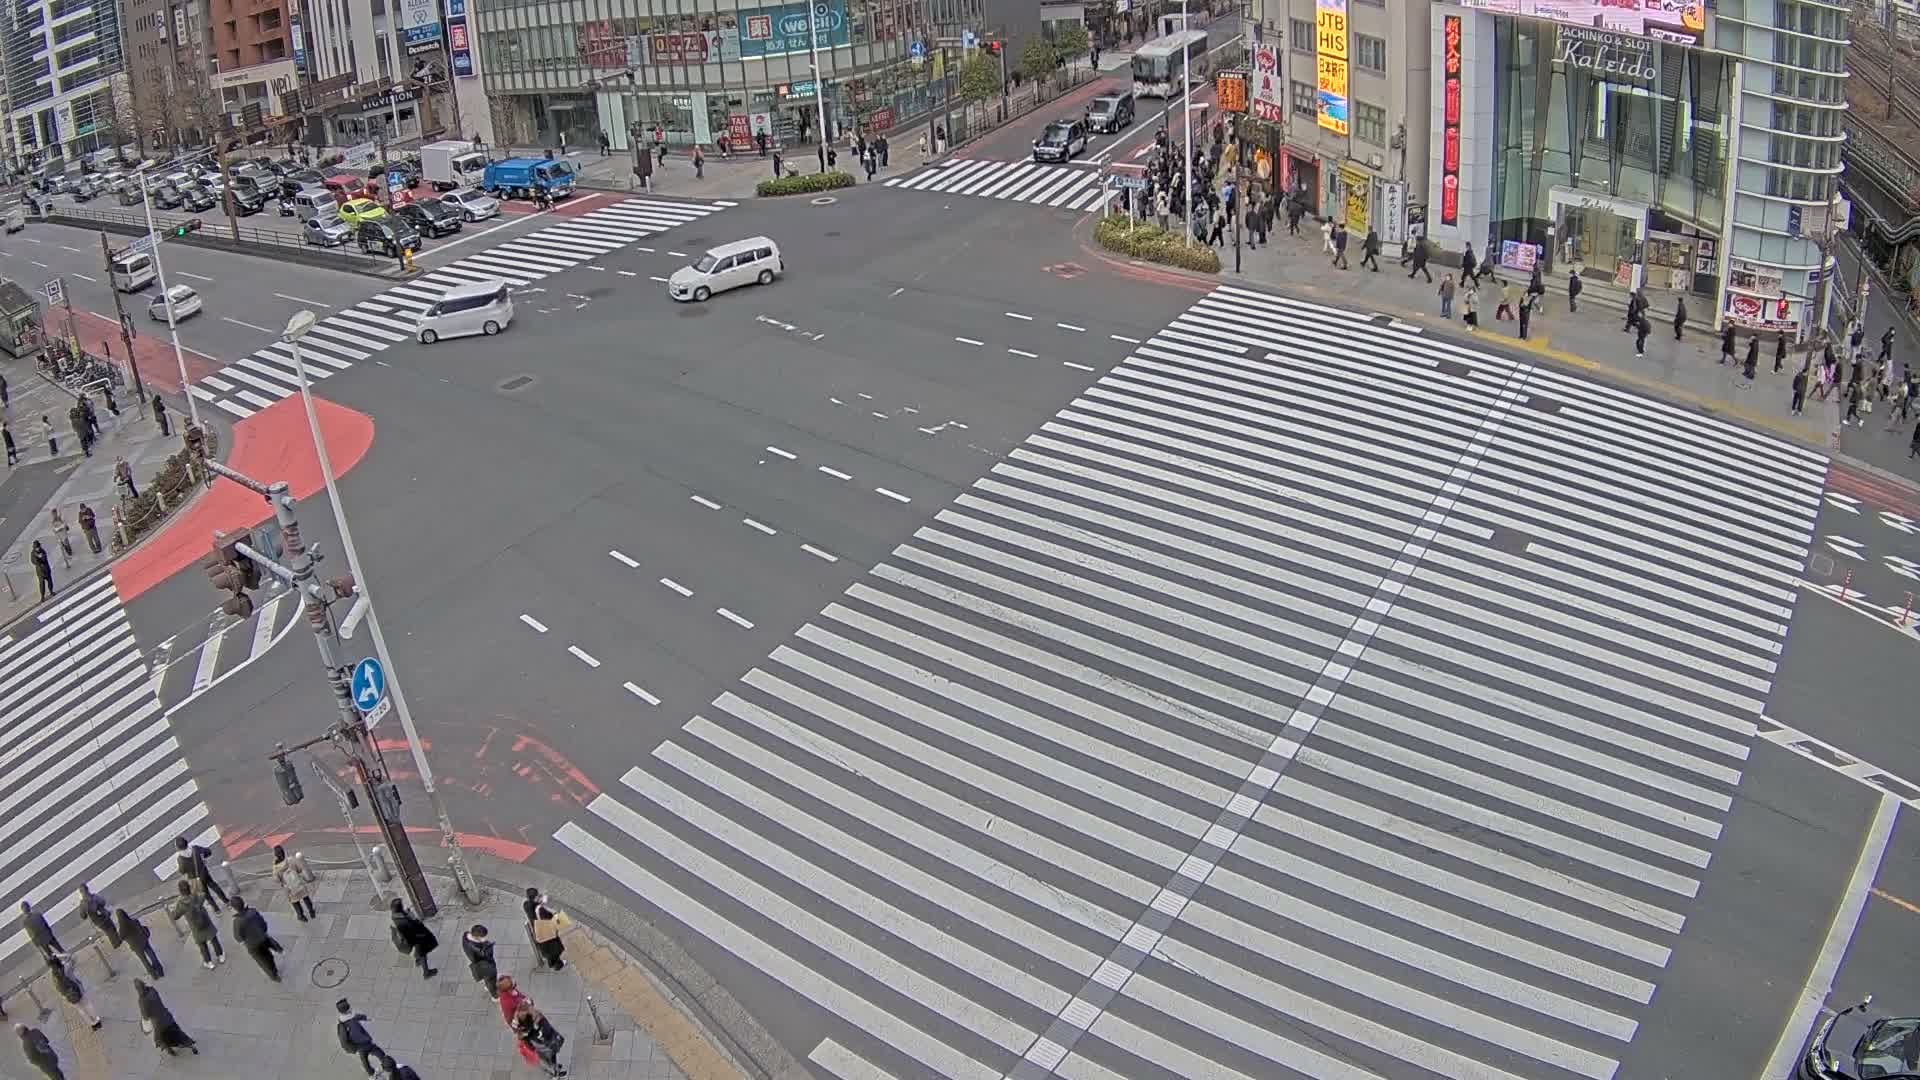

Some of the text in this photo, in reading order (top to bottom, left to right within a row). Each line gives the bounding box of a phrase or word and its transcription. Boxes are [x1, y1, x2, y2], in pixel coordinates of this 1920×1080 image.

[1319, 12, 1344, 31] JTB
[765, 34, 828, 50] 処方せん付
[1320, 31, 1344, 51] HIS
[1557, 24, 1613, 45] PACHINKO
[1614, 37, 1622, 46] &
[1625, 38, 1650, 51] SLOT
[1551, 38, 1656, 80] Kaleido
